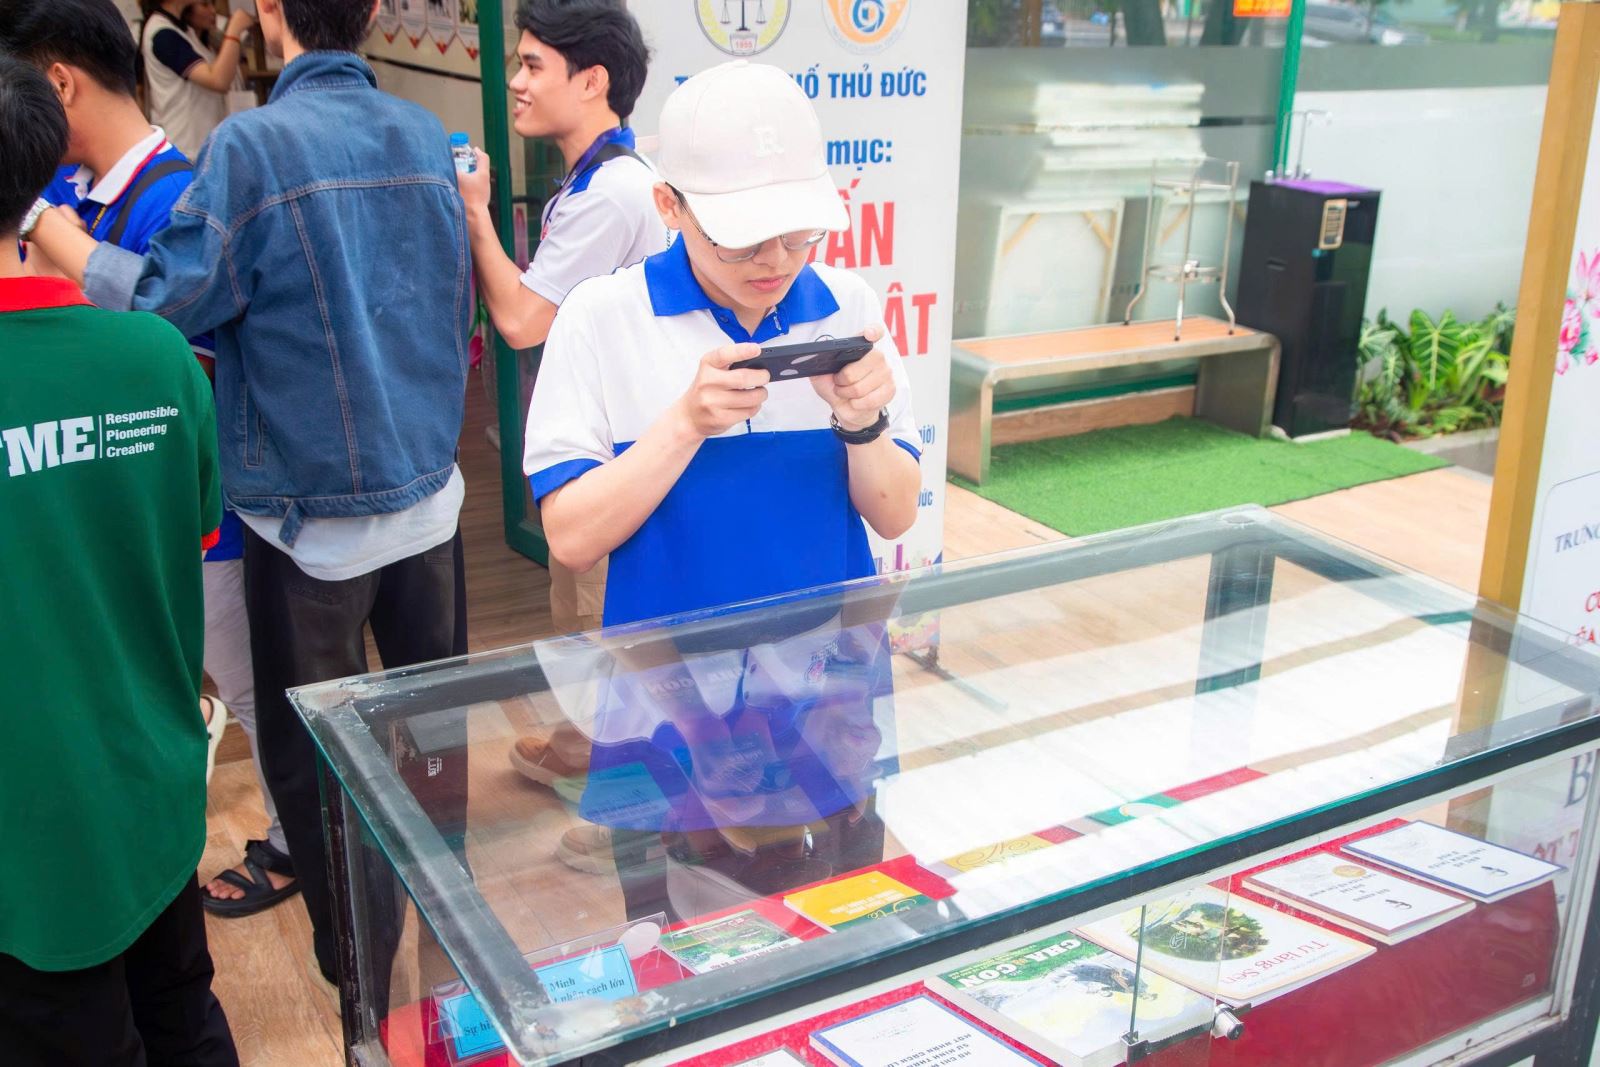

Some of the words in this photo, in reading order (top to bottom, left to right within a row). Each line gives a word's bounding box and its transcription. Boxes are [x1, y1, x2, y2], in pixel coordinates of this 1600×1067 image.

[828, 63, 872, 98] THỦ
[880, 66, 928, 97] ĐỨC
[827, 139, 893, 171] mục:
[105, 406, 179, 425] Responsible
[106, 423, 168, 442] Pioneering
[0, 415, 96, 477] ME
[106, 441, 155, 458] Creative
[1024, 938, 1081, 963] CHA
[957, 963, 1017, 989] CON
